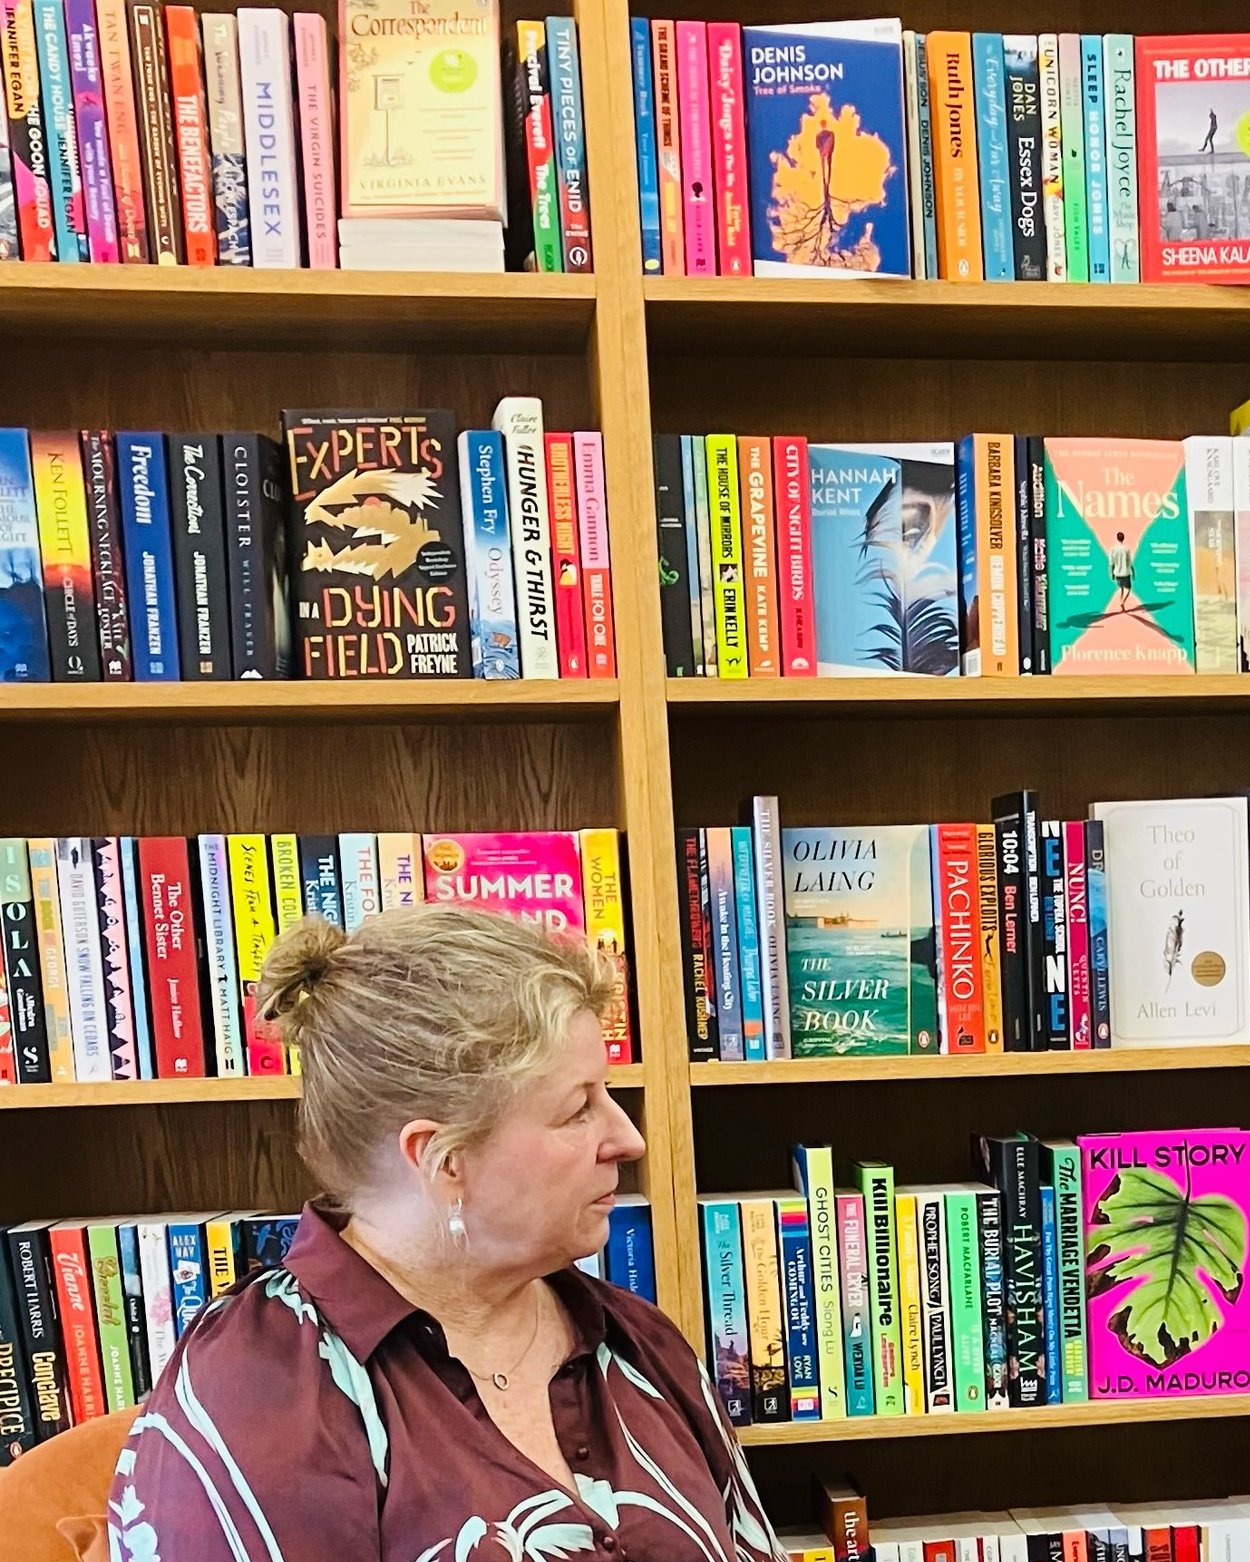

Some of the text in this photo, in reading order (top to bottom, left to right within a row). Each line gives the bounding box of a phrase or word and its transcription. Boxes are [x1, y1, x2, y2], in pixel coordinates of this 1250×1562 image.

[411, 1, 430, 15] The
[352, 12, 487, 40] Correspondent
[752, 46, 806, 65] DENIS
[1154, 60, 1190, 80] THE
[752, 65, 843, 84] JOHNSON
[946, 52, 965, 159] Ruth Jones
[1010, 75, 1024, 122] JONES
[1023, 84, 1037, 115] DAN
[556, 29, 583, 213] TINY PIECES OF ENID
[1110, 68, 1132, 197] Rachel Joyce
[177, 94, 208, 233] THE BENEFACTORS
[256, 82, 281, 236] MIDDLESEX
[306, 84, 327, 239] THE VIRGIN SUICIDES
[360, 173, 486, 190] VIRGINIA EVANS
[1017, 136, 1037, 237] Essex Dogs
[1162, 249, 1219, 266] SHEENA
[287, 426, 442, 502] EXPERTS
[716, 447, 727, 465] THE
[717, 467, 728, 499] HOUSE
[812, 469, 896, 484] HANNAH
[1103, 467, 1135, 486] The
[233, 446, 252, 547] CLOISTER
[812, 488, 862, 504] KENT
[1055, 480, 1180, 521] Names
[478, 444, 504, 616] Stephen Fry Odyssey
[516, 449, 548, 640] HUNGER & THIRST
[720, 516, 733, 559] MIRRORS
[129, 444, 161, 656] Freedom JONATHAN FRANZEN
[299, 584, 457, 631] IN A DYING
[723, 588, 737, 616] ERIN
[407, 633, 458, 653] PATRICK
[725, 618, 739, 648] KELLY
[304, 632, 404, 677] FIELD
[410, 654, 458, 674] FREYNE
[1062, 648, 1187, 671] Florence Knapp
[793, 839, 877, 861] OLIVIA
[1147, 826, 1195, 844] Theo
[1163, 855, 1182, 871] of
[436, 874, 574, 901] SUMMER
[793, 871, 875, 893] LAING
[1003, 830, 1018, 954] 10:04 Ben Lerner
[1068, 862, 1086, 923] NUNC!
[1140, 882, 1205, 897] Golden
[5, 845, 32, 978] ISOLA
[151, 872, 168, 961] Bennet Sister
[166, 882, 185, 950] The Other
[946, 861, 974, 1000] PACHINKO
[801, 958, 832, 972] THE
[801, 979, 890, 1002] SILVER
[801, 1009, 879, 1032] BOOK
[1138, 1002, 1216, 1019] Allen Levi
[1090, 1144, 1246, 1169] KILL STORY
[815, 1188, 833, 1292] GHOST CITIES
[924, 1206, 945, 1386] PROPHET SONG PAUL LYNCH
[1012, 1225, 1034, 1378] HAVISHAM
[19, 1241, 62, 1423] ROBERT HARRIS Conclave
[1098, 1370, 1250, 1394] J.D. MADURO
[844, 1512, 859, 1537] the
